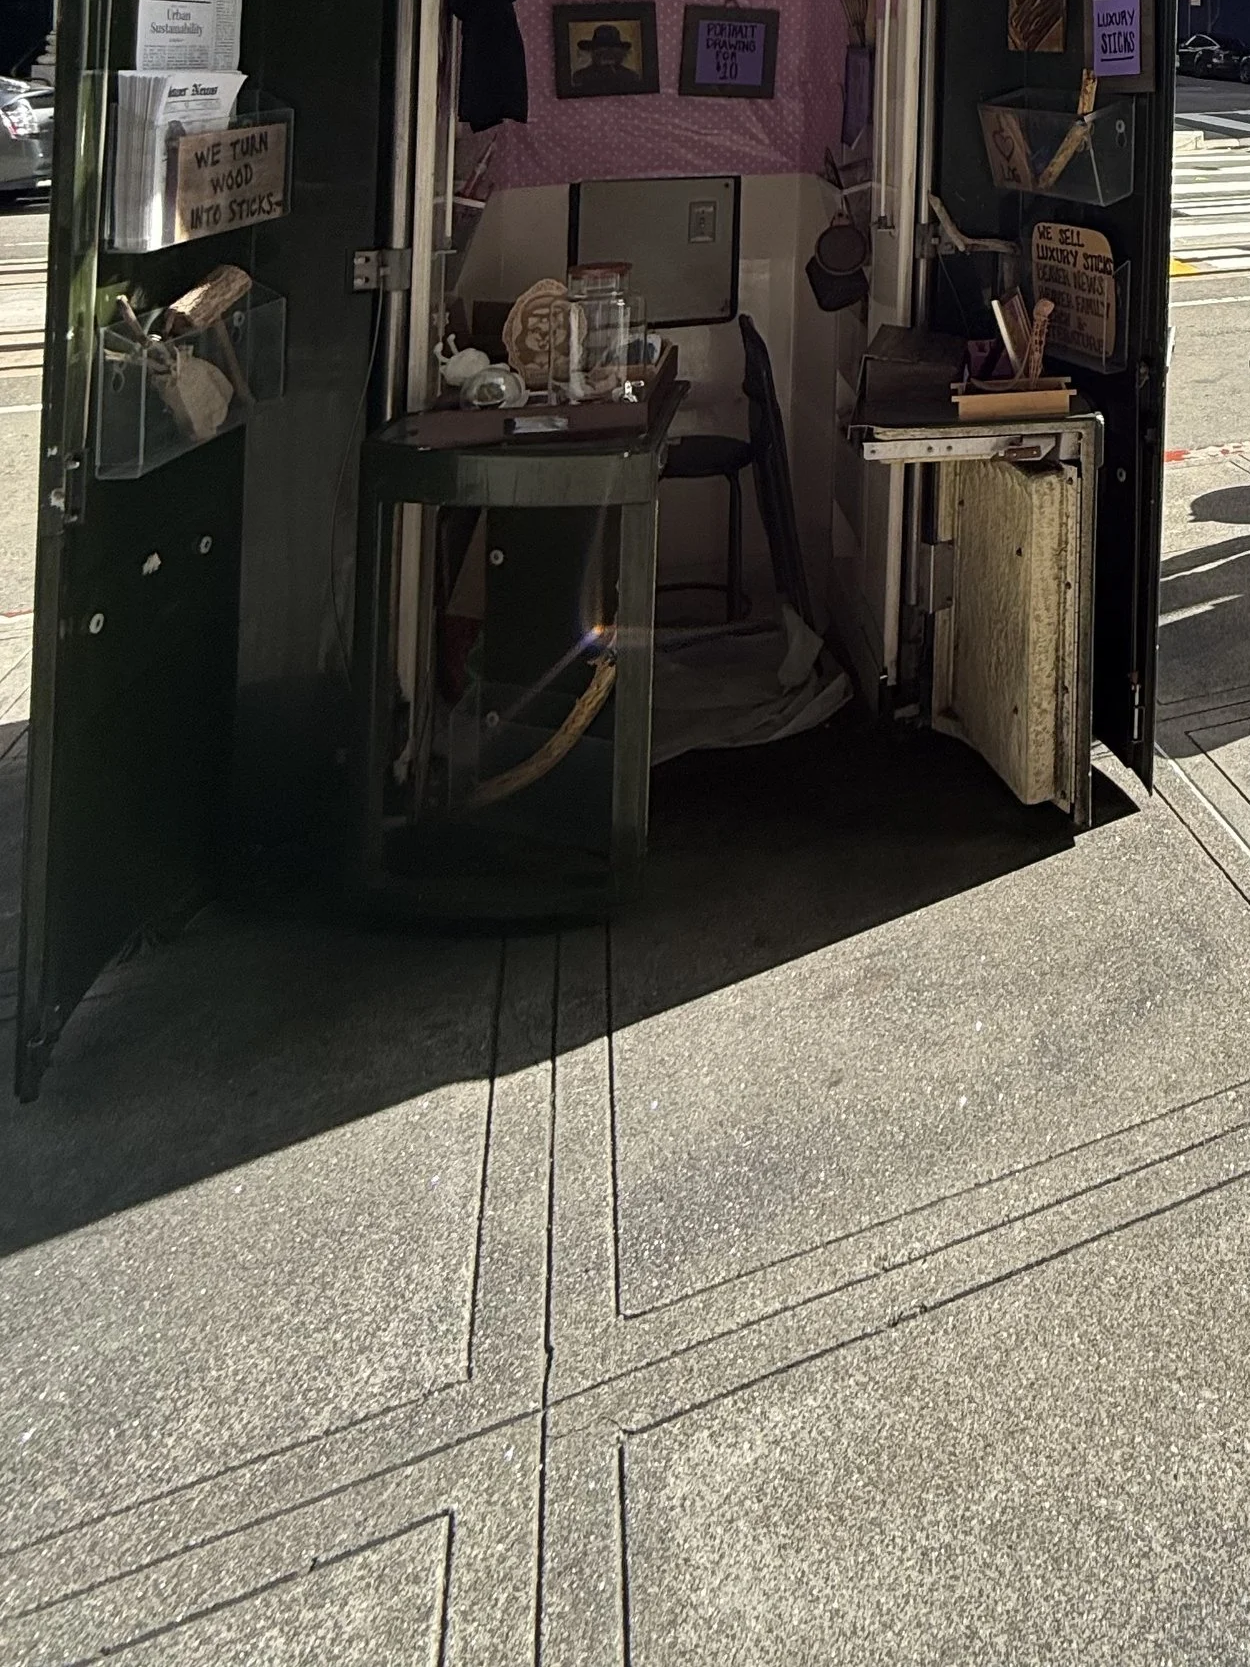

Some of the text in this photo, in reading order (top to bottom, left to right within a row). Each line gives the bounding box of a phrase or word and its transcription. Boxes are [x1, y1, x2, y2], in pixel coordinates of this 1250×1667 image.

[167, 9, 191, 21] Urban
[1097, 9, 1136, 28] LUXURY
[150, 22, 203, 36] Sustainability
[706, 22, 757, 39] PORTRAIT
[706, 37, 757, 53] DRAWING
[1101, 31, 1136, 55] STICKS
[716, 50, 737, 61] FOR
[194, 131, 269, 170] WE TURN
[210, 163, 253, 195] WOOD
[190, 203, 221, 231] INTO
[1037, 225, 1085, 247] WE SELL
[1036, 243, 1079, 268] LUXURY
